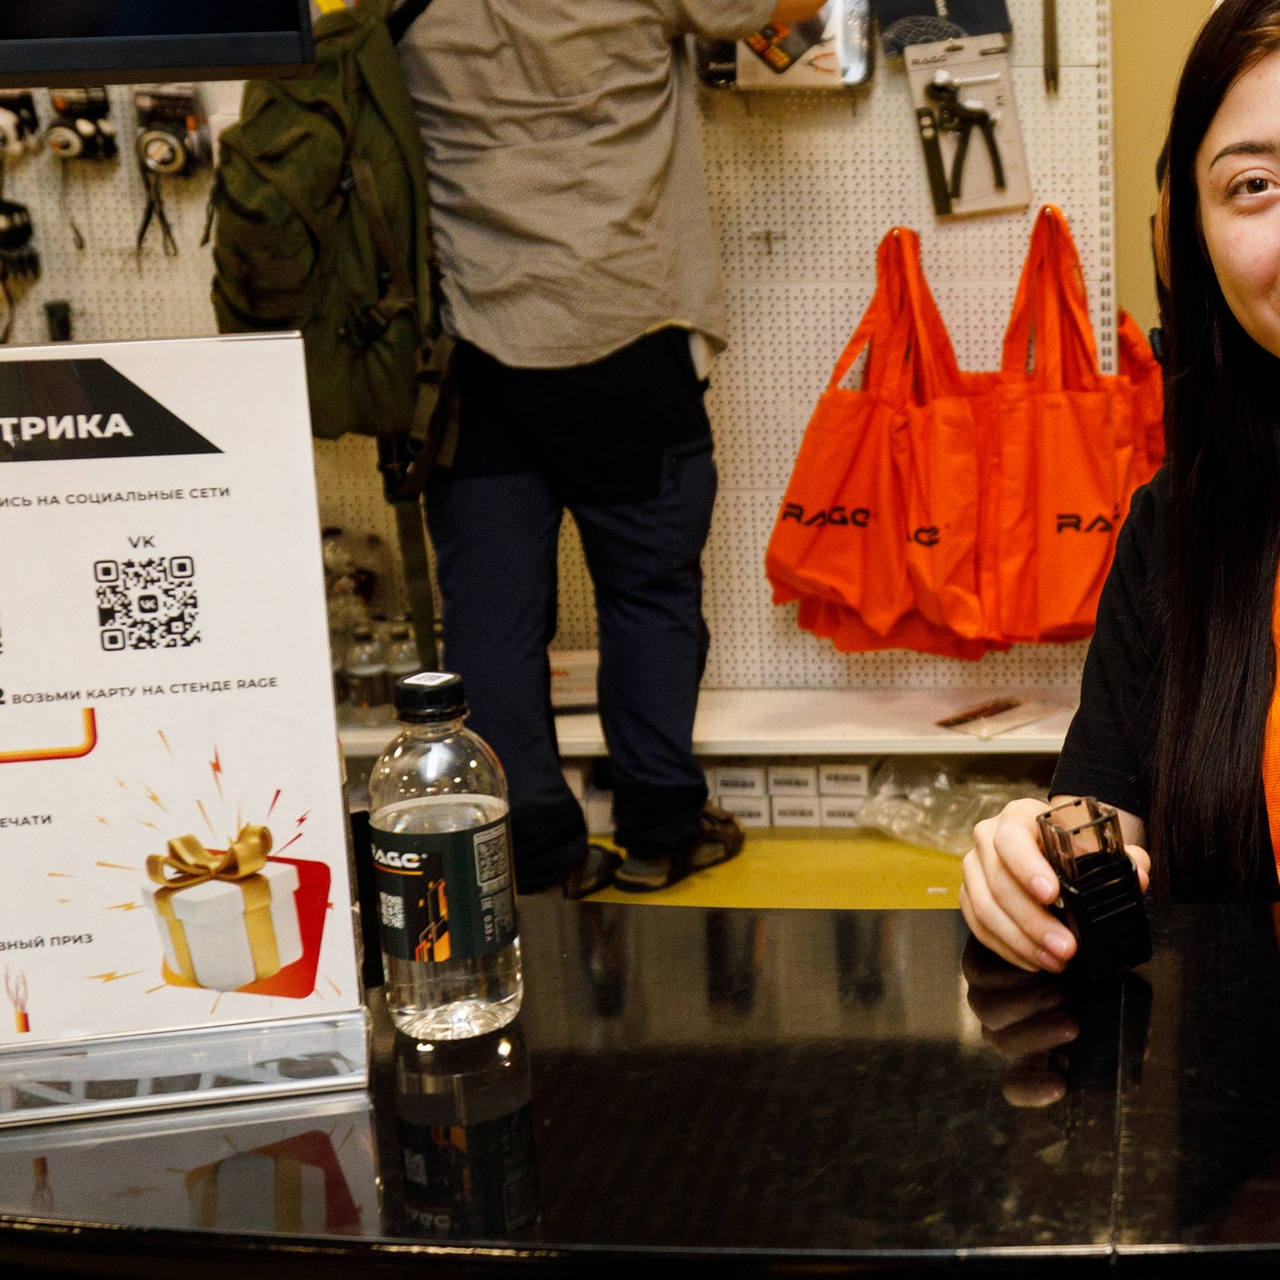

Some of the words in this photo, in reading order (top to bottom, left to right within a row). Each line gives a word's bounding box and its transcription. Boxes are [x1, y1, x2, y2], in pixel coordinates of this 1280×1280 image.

[37, 494, 61, 506] НА
[66, 488, 184, 505] СОЦИАЛЬНЫЕ
[189, 486, 231, 499] СЕТИ
[127, 535, 155, 549] VK
[12, 690, 81, 704] ВОЗЬМИ
[86, 686, 137, 701] КАРТУ
[142, 684, 165, 696] НА
[170, 680, 232, 694] СТЕНДЕ
[237, 676, 278, 689] RAGE
[50, 933, 93, 946] ПРИЗ
